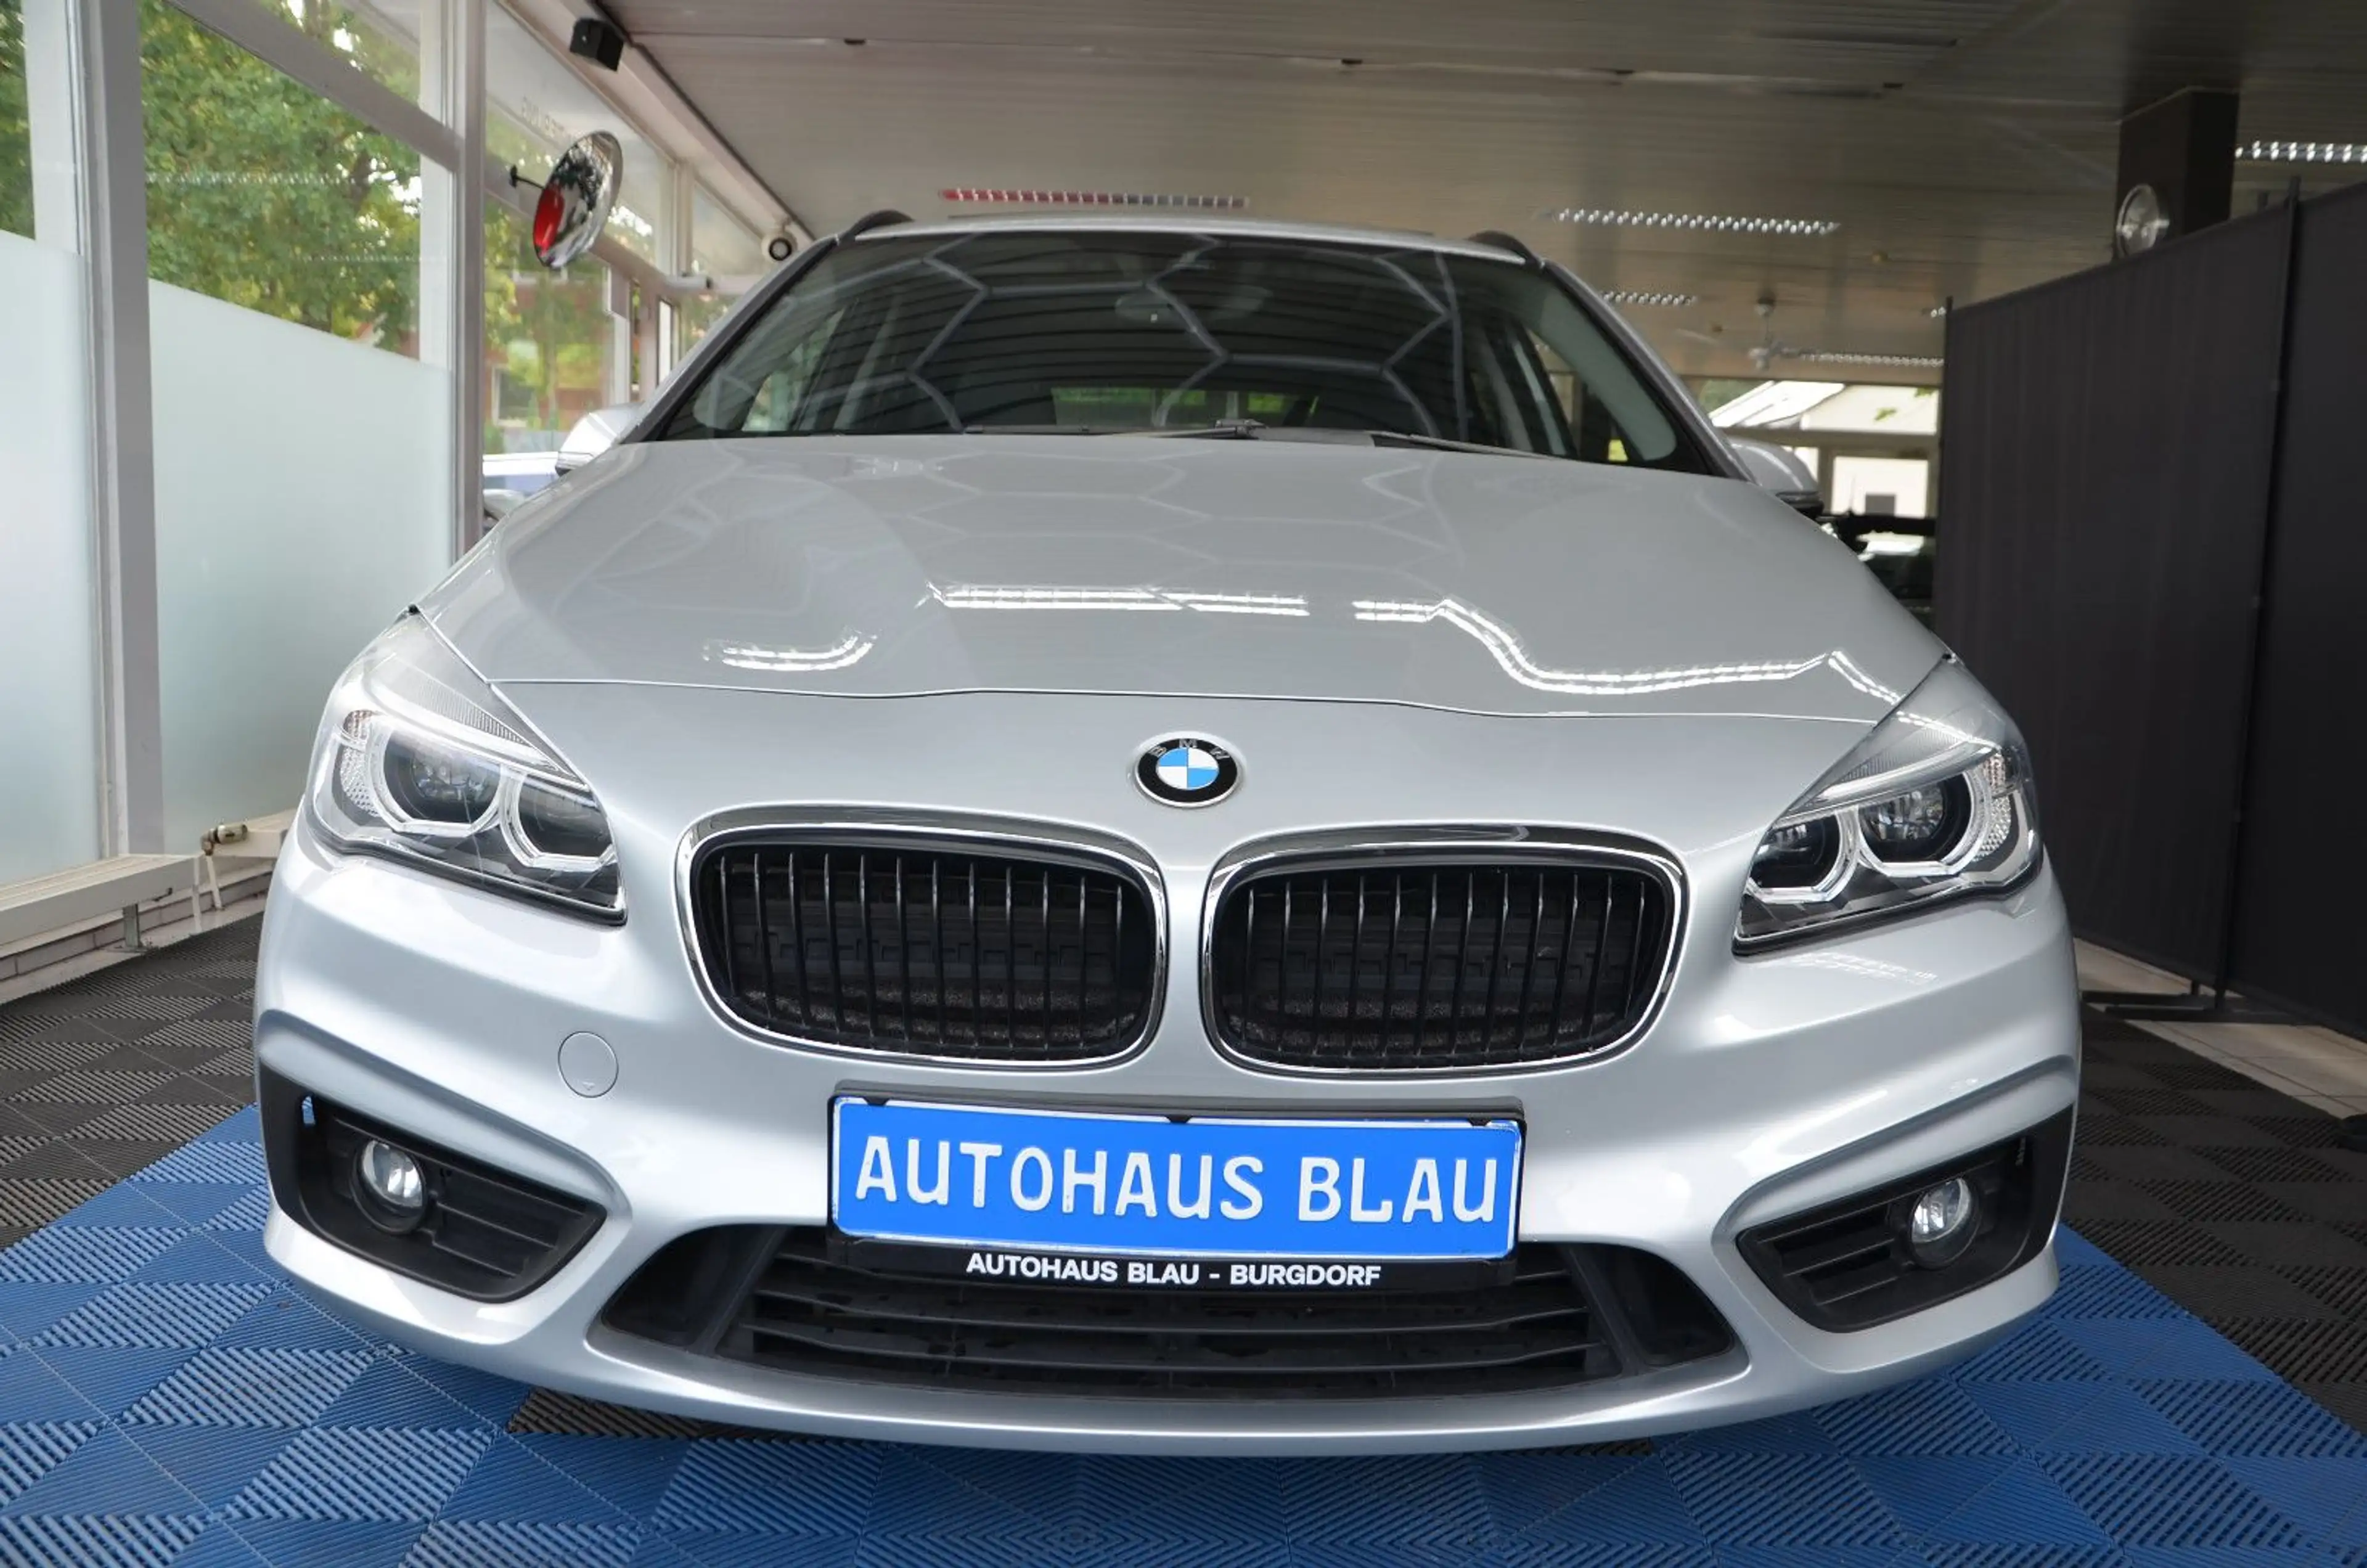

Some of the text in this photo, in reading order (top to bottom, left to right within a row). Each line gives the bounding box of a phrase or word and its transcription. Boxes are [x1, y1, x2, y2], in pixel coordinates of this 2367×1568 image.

[1147, 738, 1230, 759] BMW
[855, 1135, 1497, 1223] AUTOHAUS BLAU
[965, 1252, 1118, 1283] AUTOHAUS
[1127, 1261, 1200, 1286] BLAU
[1230, 1264, 1382, 1286] BURGDORF
